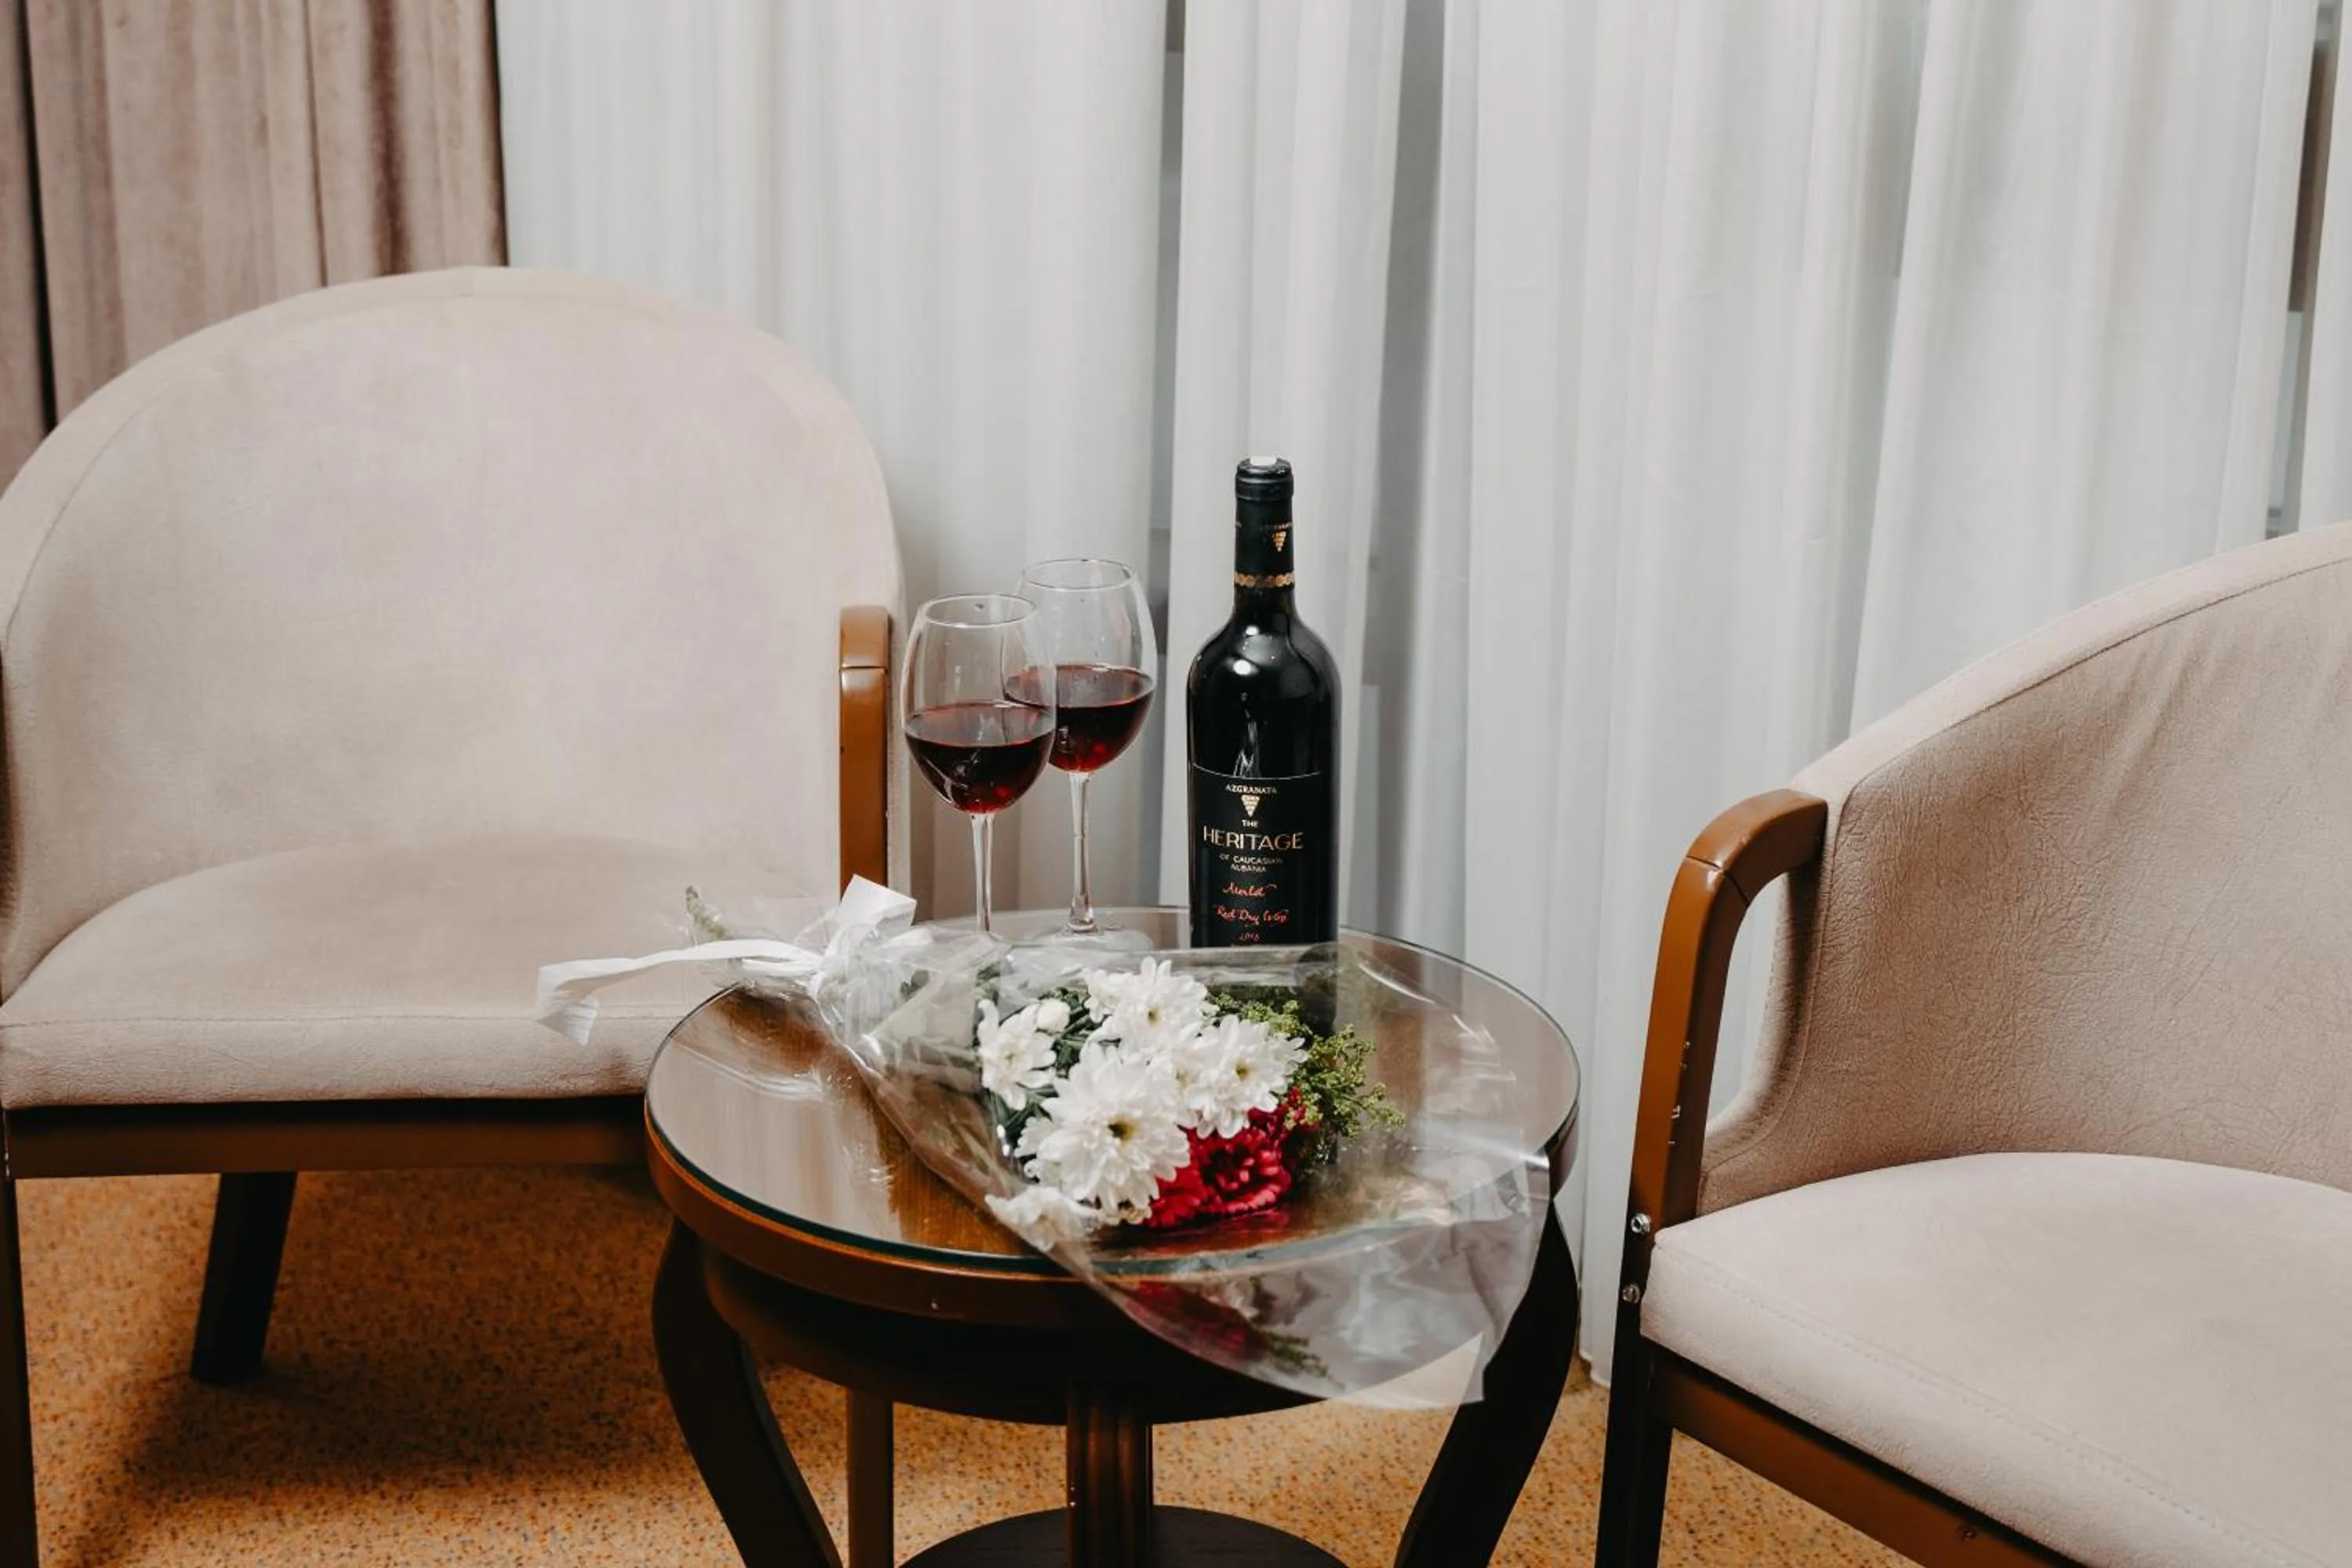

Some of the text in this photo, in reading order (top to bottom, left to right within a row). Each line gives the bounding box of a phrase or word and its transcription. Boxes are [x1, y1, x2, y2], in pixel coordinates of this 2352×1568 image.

[1226, 785, 1277, 794] AZGRANATA
[1242, 819, 1259, 828] THE
[1203, 825, 1304, 851] HERITAGE
[1231, 863, 1266, 873] ALBANIA
